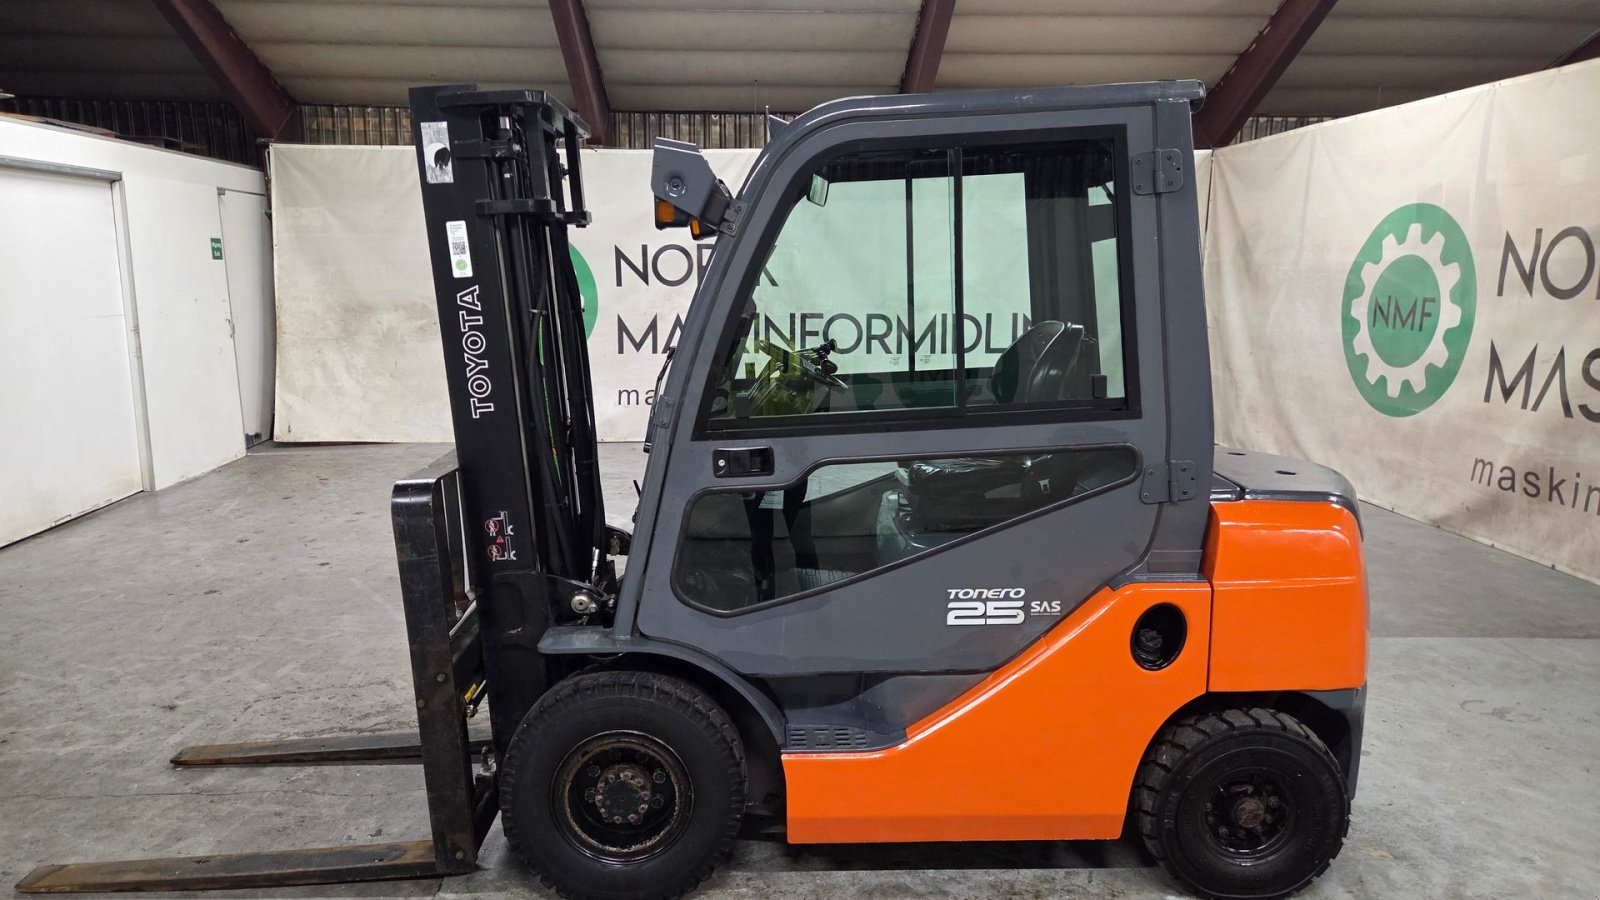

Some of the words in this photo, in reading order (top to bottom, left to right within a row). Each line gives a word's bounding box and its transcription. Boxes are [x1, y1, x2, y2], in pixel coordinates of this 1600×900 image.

[1497, 226, 1600, 300] NO
[1372, 295, 1437, 332] NMF
[456, 284, 495, 419] TOYOTA
[946, 601, 1025, 625] 25
[1030, 600, 1061, 613] SAS
